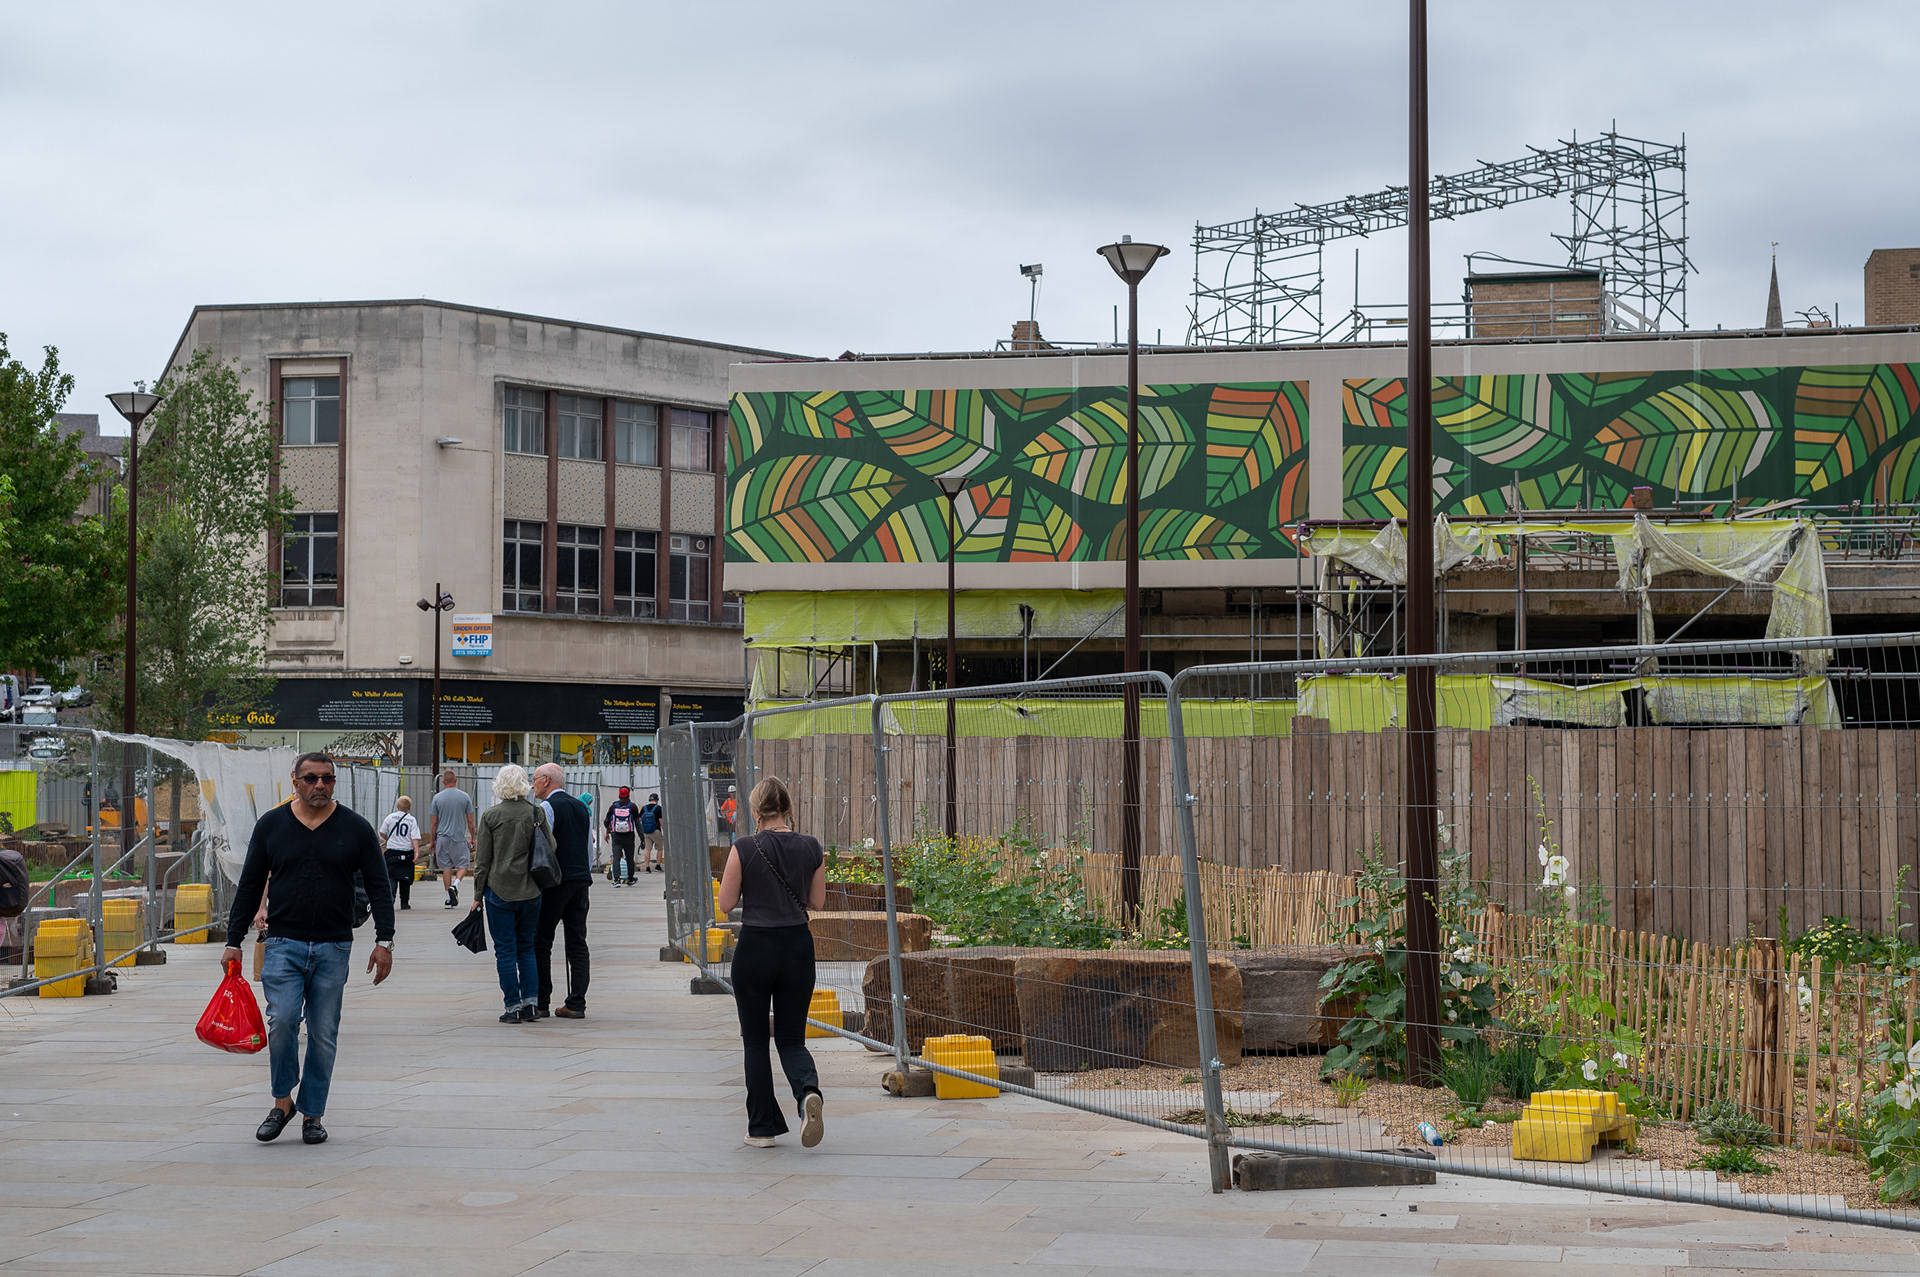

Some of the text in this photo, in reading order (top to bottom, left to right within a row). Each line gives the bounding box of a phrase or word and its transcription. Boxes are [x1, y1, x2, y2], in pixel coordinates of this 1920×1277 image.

[469, 635, 488, 644] FHP
[466, 695, 483, 703] Market
[636, 700, 656, 708] Tramways
[247, 711, 276, 725] Gate
[395, 822, 409, 838] 10
